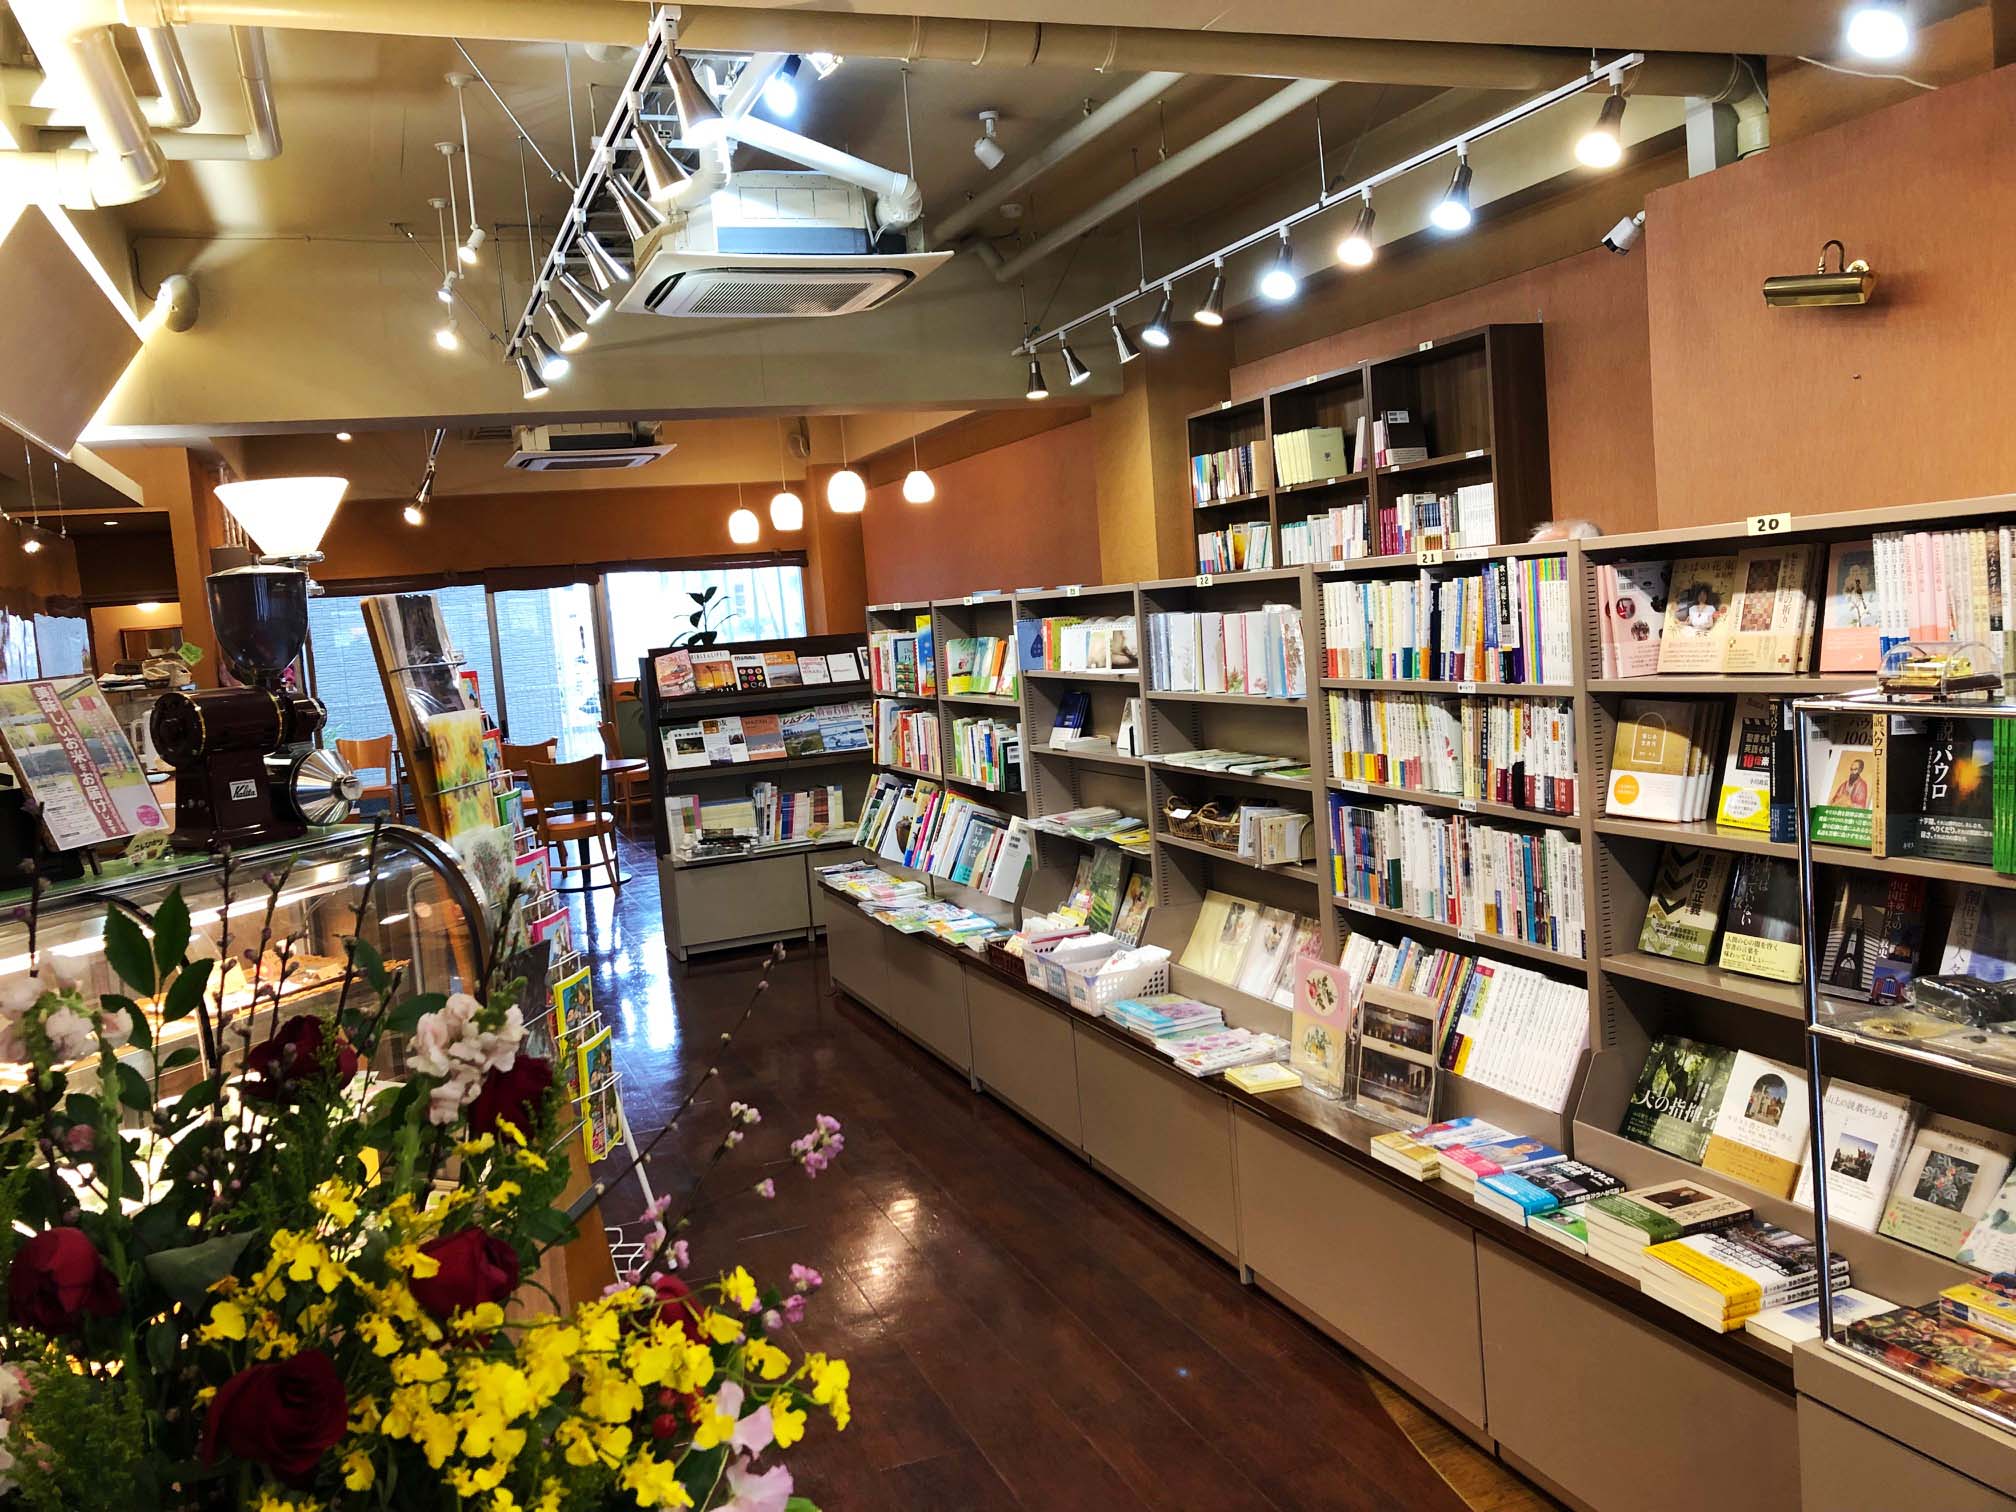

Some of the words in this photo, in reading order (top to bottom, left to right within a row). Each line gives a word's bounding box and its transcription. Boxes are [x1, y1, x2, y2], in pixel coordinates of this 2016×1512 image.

[1757, 518, 1779, 532] 20
[1422, 553, 1435, 563] 21
[1200, 577, 1209, 585] 22
[233, 784, 257, 799] Kalita
